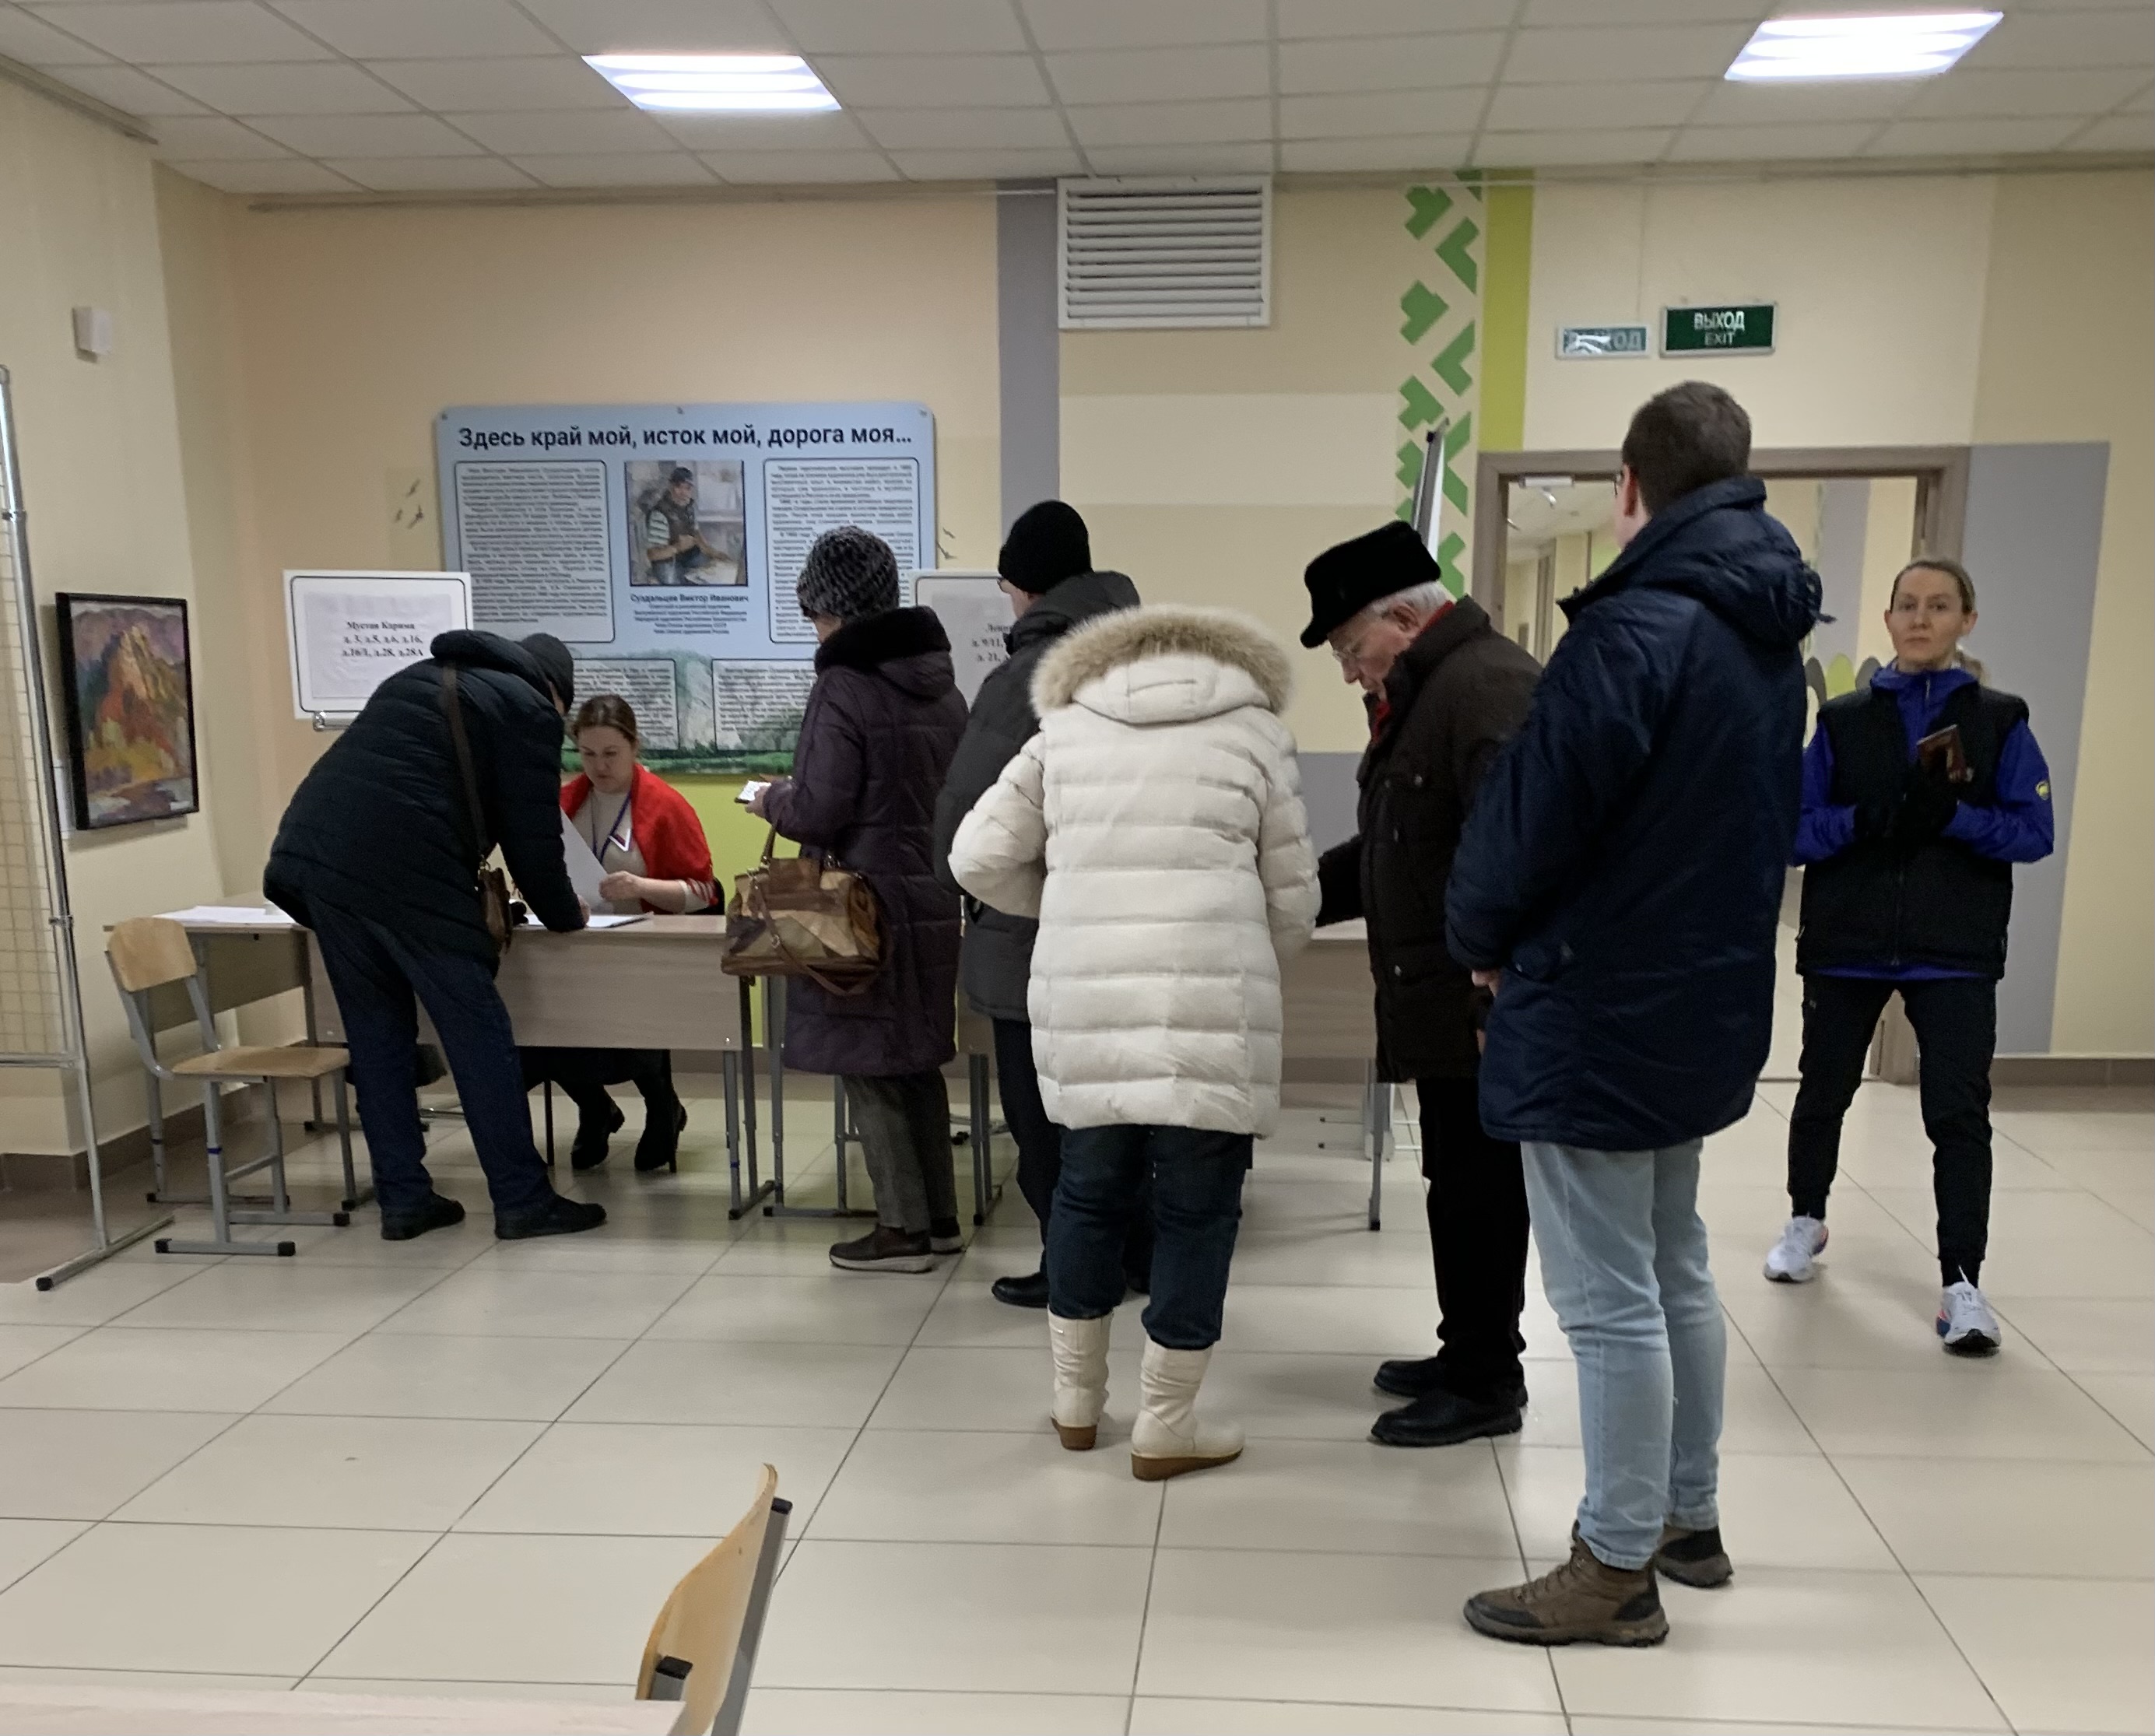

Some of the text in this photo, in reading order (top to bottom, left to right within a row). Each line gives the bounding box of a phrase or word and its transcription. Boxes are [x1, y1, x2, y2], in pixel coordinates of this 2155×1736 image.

[1693, 310, 1746, 331] ВЫХОД
[1704, 332, 1735, 345] EXIT
[459, 423, 911, 451] Здесь край мой, исток мой, дорога моя...
[679, 593, 708, 603] Виктор
